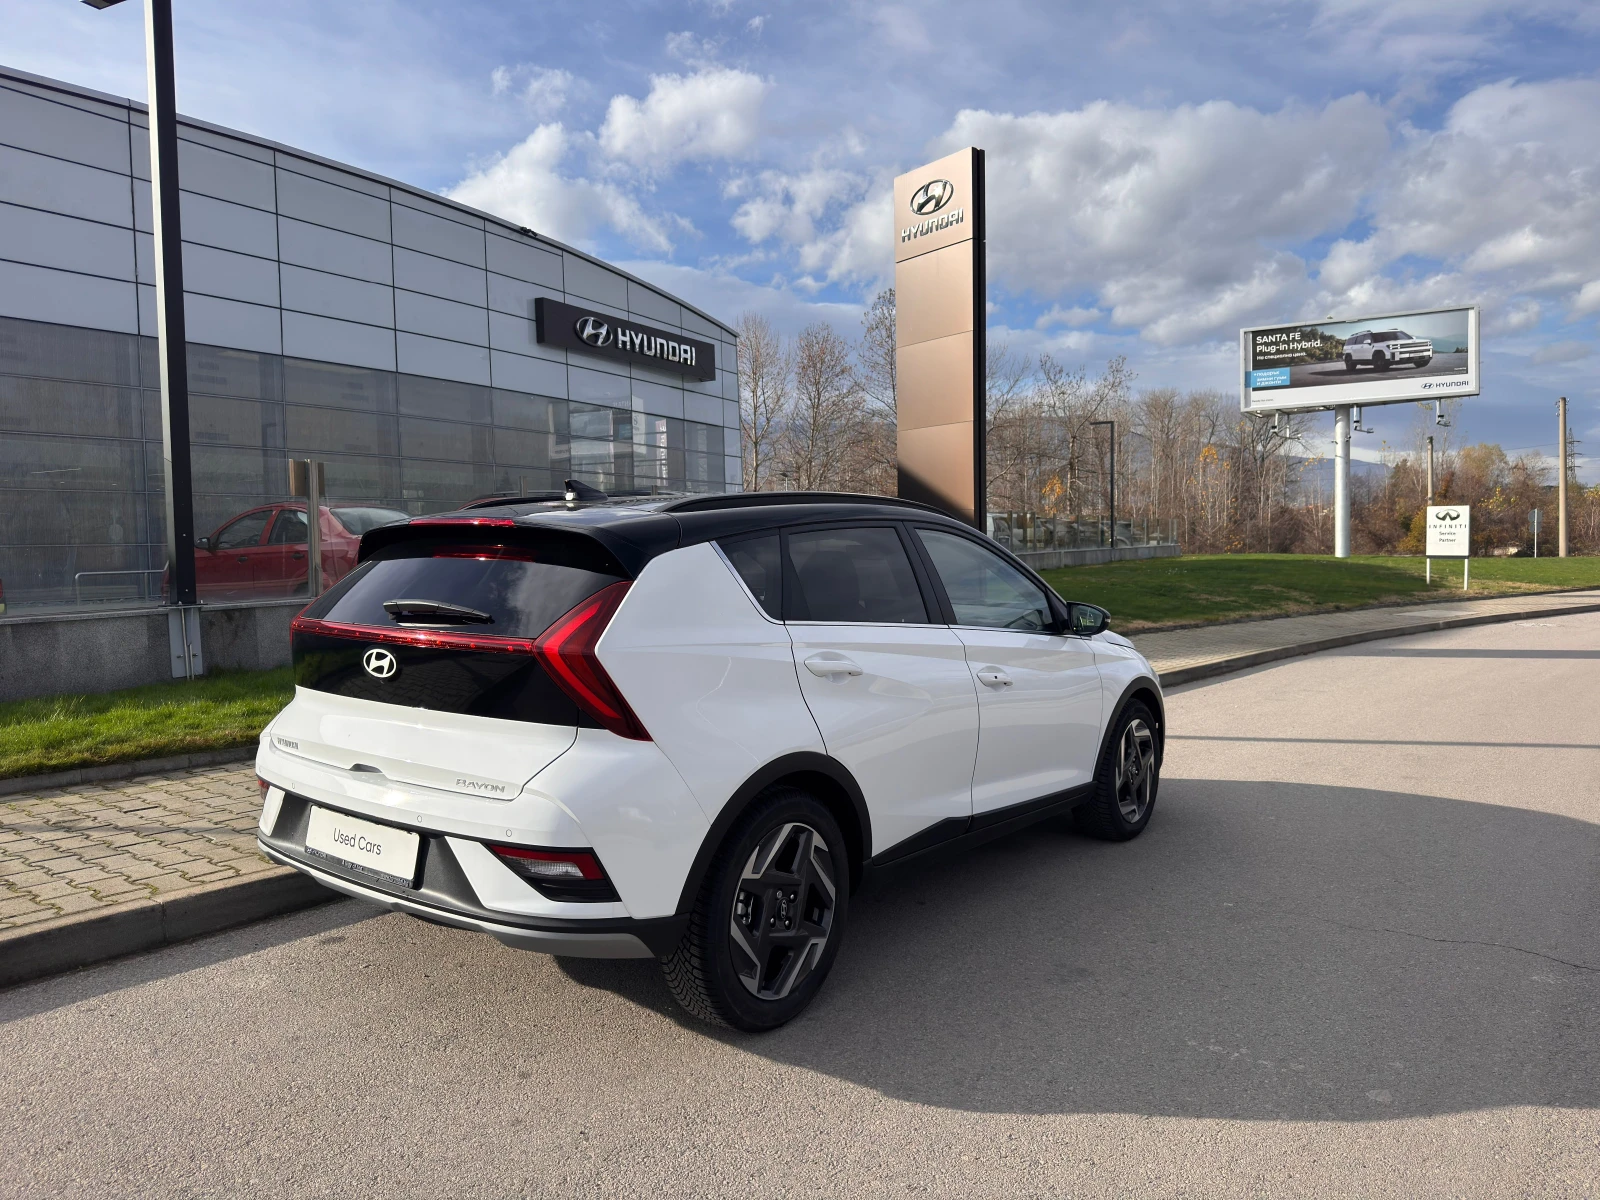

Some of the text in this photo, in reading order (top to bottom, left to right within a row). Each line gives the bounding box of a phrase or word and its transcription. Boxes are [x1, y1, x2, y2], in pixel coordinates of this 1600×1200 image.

[901, 207, 964, 243] HYUNDAI
[1256, 332, 1302, 344] SANTA FE
[617, 327, 696, 366] HYUNDAI
[1256, 339, 1323, 353] Plug-in Hybrid.
[1435, 380, 1469, 388] HYUNDAI
[456, 778, 506, 793] BAYON
[333, 827, 382, 856] Used Cars
